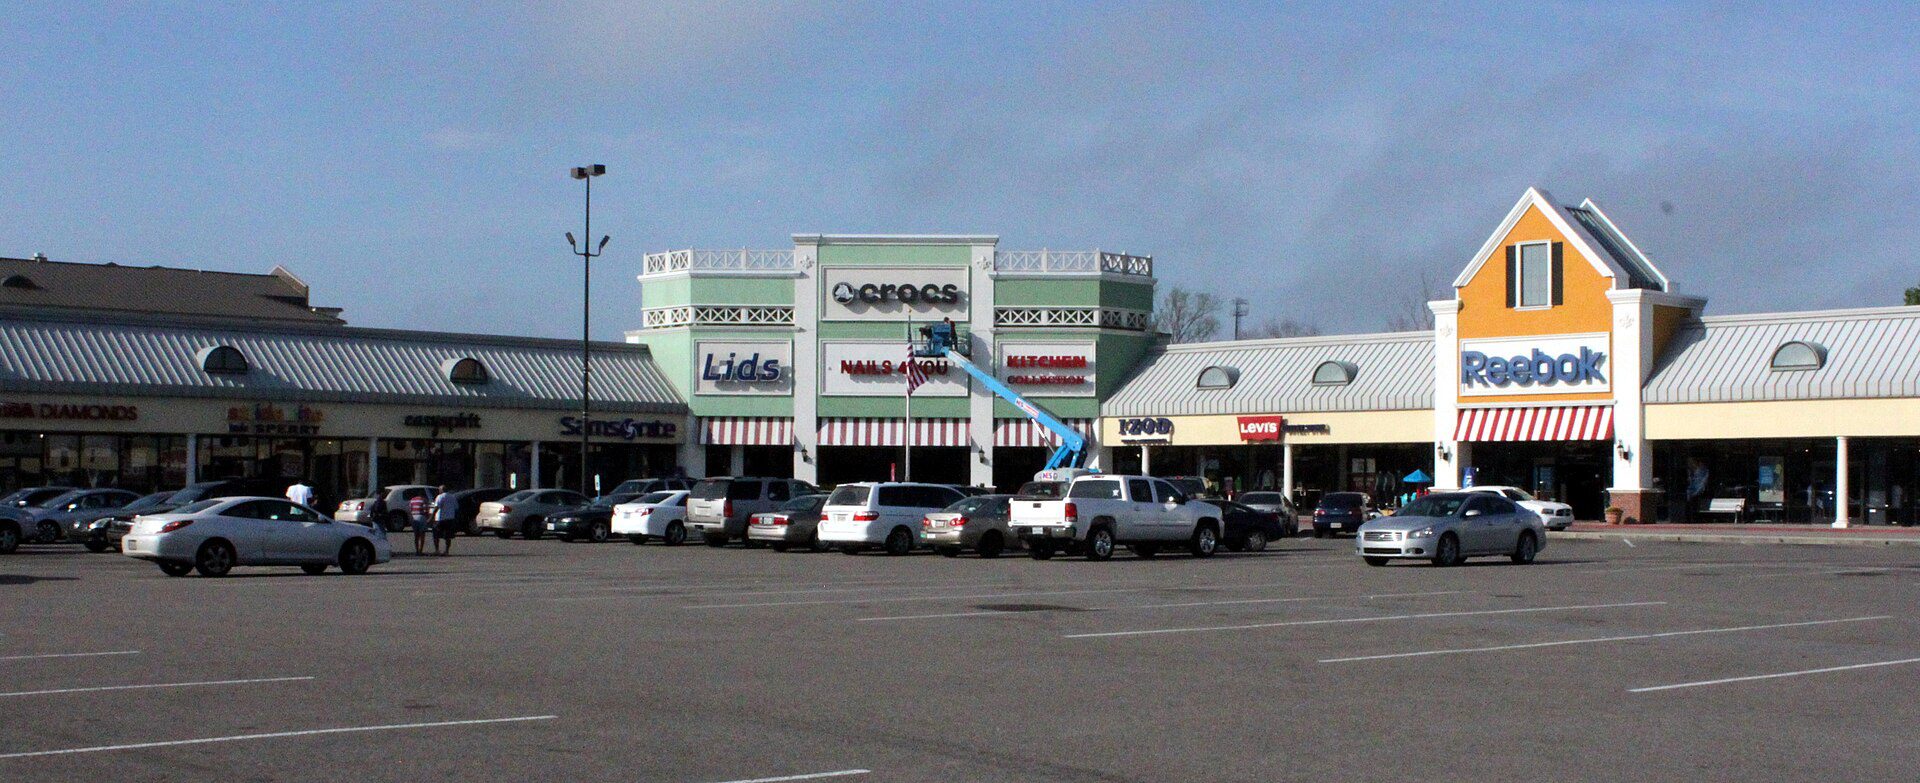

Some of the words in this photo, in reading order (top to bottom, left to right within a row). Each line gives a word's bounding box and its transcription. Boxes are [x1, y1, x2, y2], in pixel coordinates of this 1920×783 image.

[858, 283, 957, 304] crocs
[702, 353, 781, 381] Lids
[840, 360, 893, 375] NAILS
[898, 360, 909, 375] 4
[1007, 355, 1086, 368] KITCHEN
[1461, 346, 1608, 385] Reebok
[1007, 375, 1085, 385] COLLECTION
[40, 403, 138, 420] DIAMONDS
[560, 416, 677, 440] Samsonite
[1118, 416, 1172, 436] IZOD
